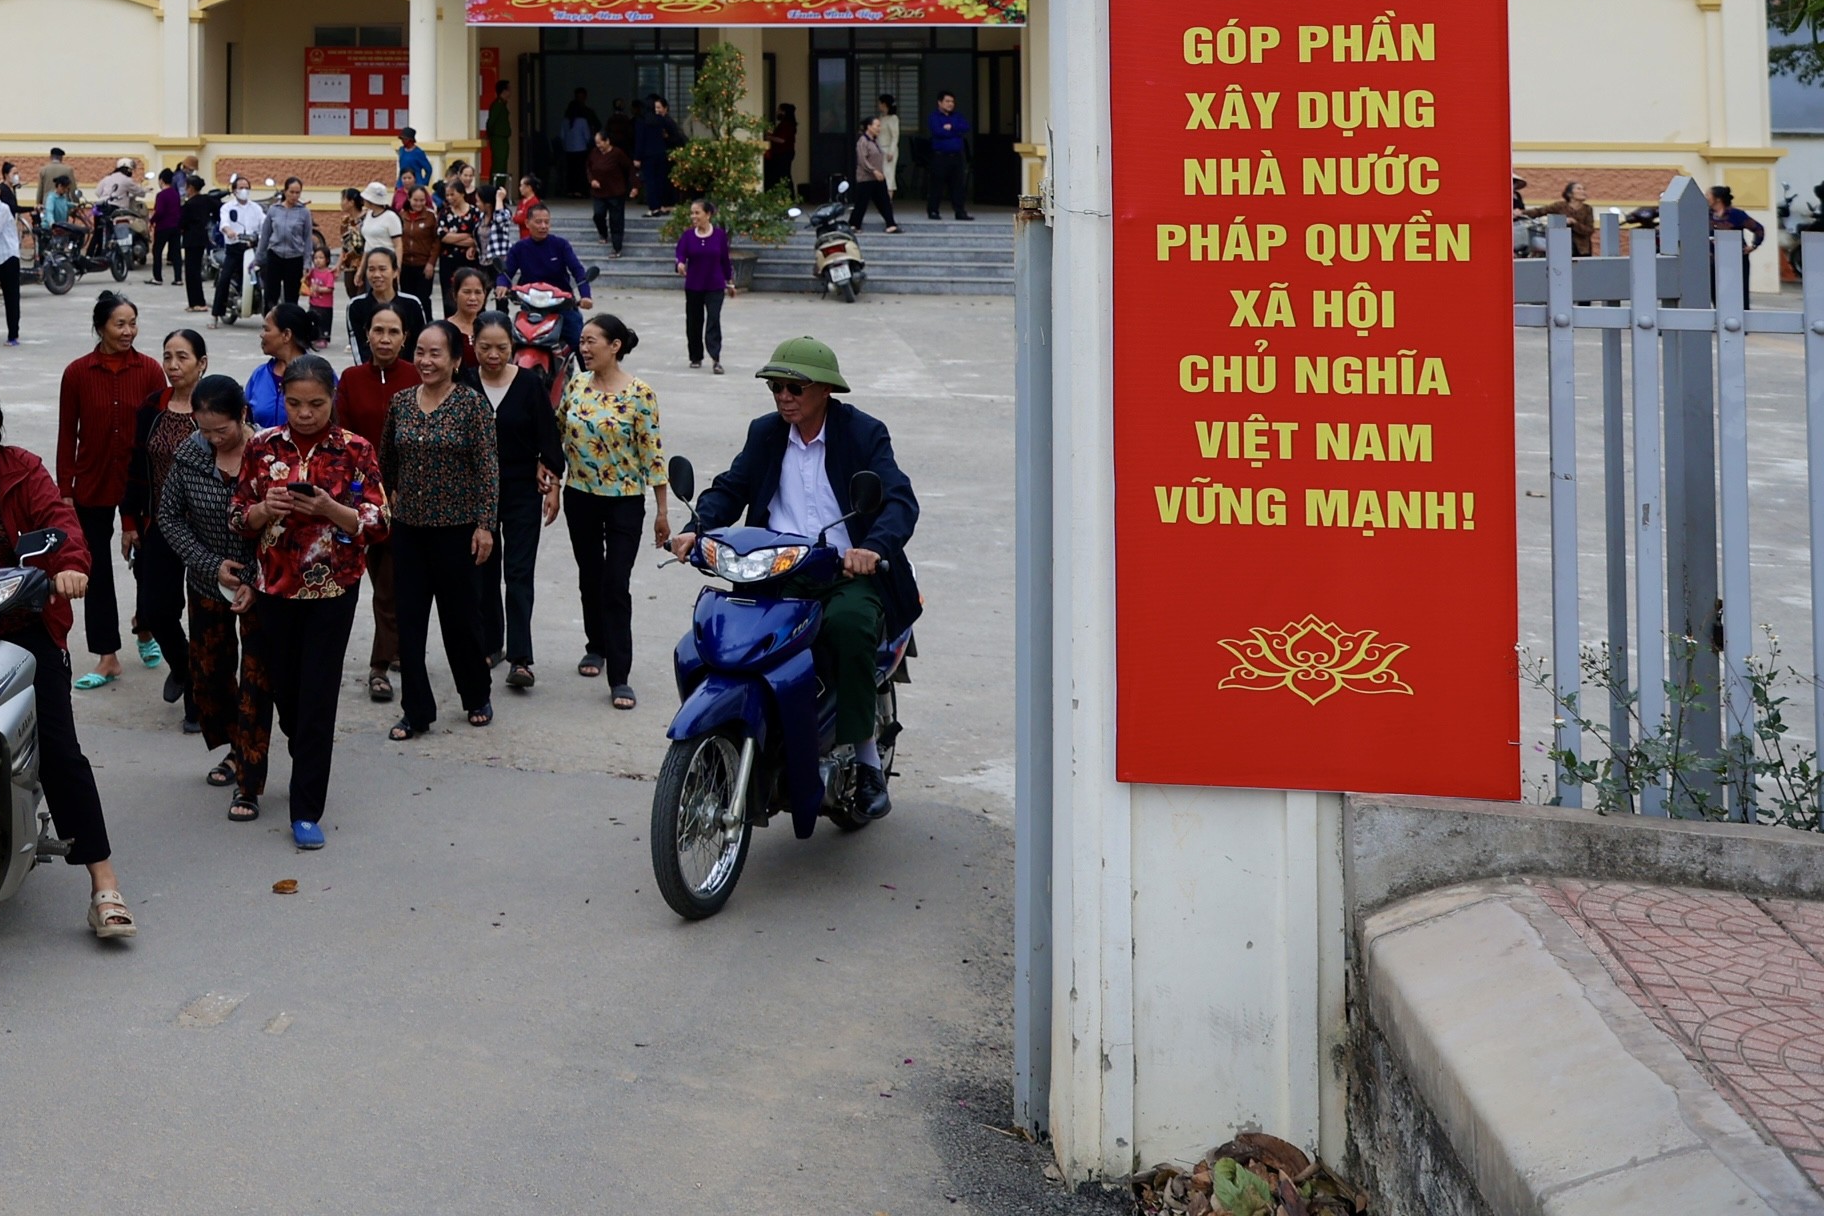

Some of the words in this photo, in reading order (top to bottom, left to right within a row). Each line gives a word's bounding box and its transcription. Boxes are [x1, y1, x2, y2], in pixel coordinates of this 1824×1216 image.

[1184, 19, 1280, 64] GÓP
[1299, 11, 1434, 62] PHẦN
[1186, 85, 1280, 129] XÂY
[1298, 87, 1434, 136] DỰNG
[1184, 150, 1285, 195] NHÀ
[1303, 146, 1439, 195] NƯỚC
[1157, 216, 1286, 261] PHÁP
[1306, 210, 1469, 265] QUYỀN
[1230, 283, 1296, 327] XÃ
[1313, 282, 1394, 336] HỘI
[1180, 340, 1276, 393] CHỦ
[1295, 350, 1450, 395] NGHĨA
[1195, 414, 1298, 467] VIỆT
[1316, 423, 1432, 462] NAM
[1154, 477, 1286, 525] VỮNG
[1306, 489, 1474, 536] MẠNH!
